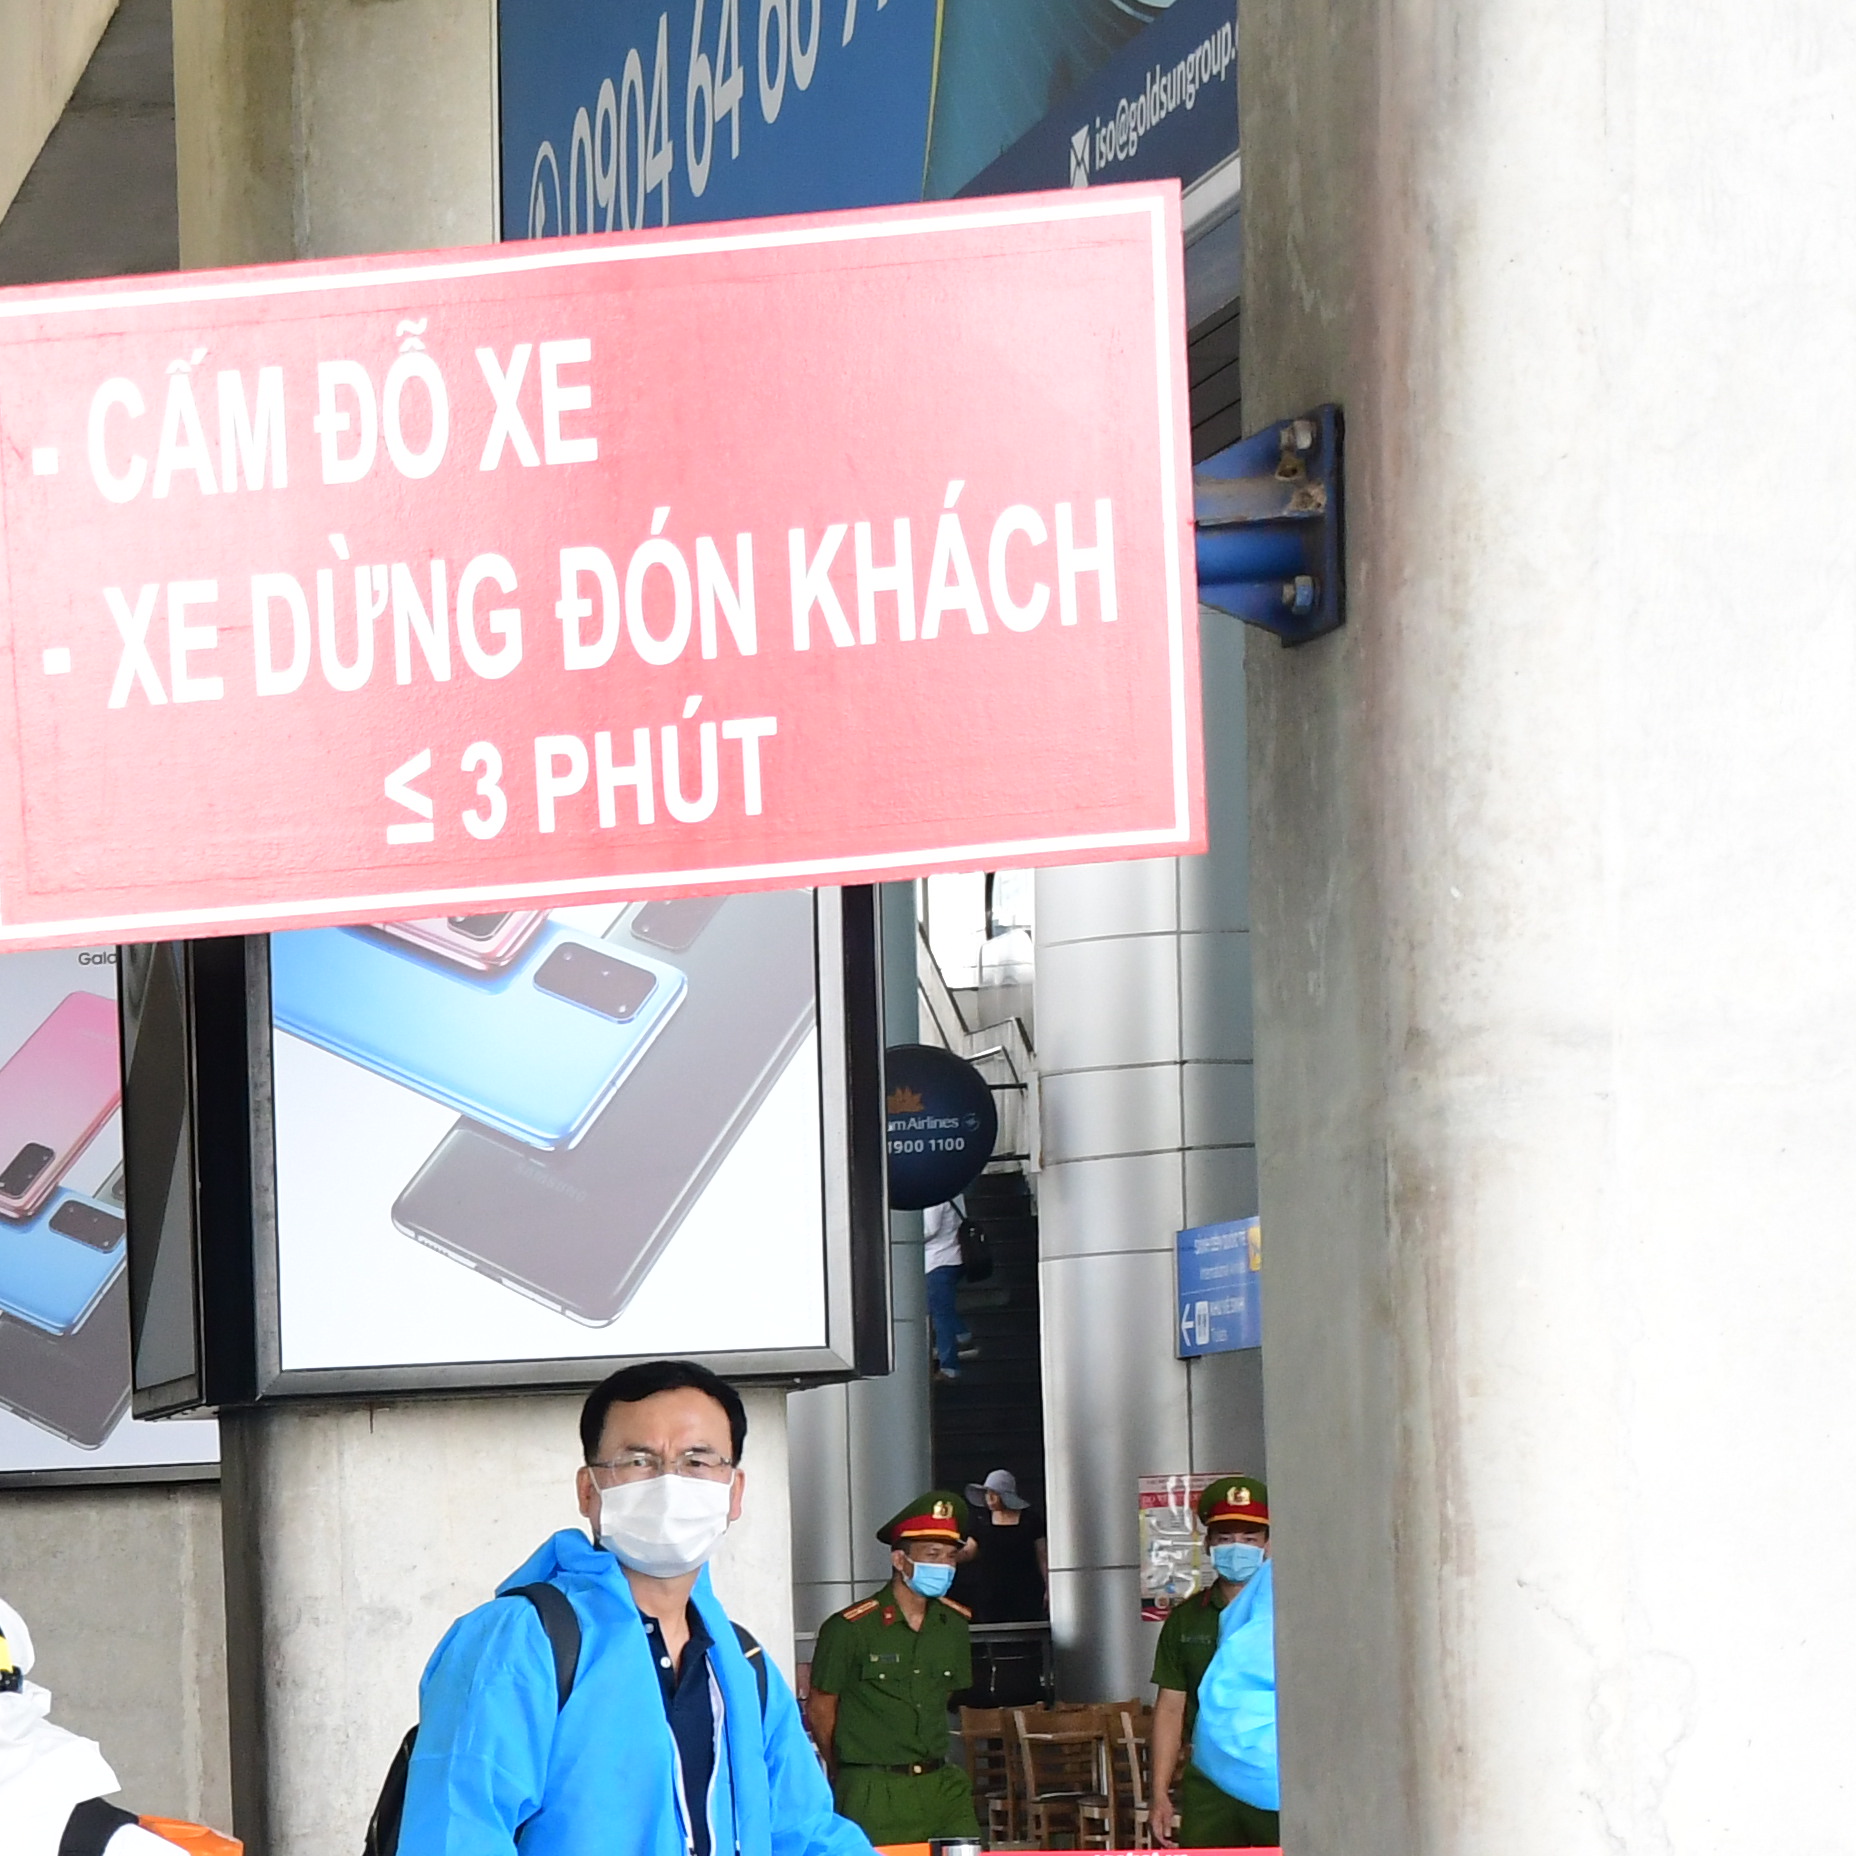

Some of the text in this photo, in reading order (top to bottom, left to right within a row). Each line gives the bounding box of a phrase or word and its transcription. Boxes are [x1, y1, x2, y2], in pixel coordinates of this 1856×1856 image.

[569, 11, 673, 236] 0904
[686, 0, 745, 198] 64
[1095, 21, 1238, 171] iso@goldsungroup.
[88, 317, 600, 504] CẤM ĐỖ XE
[103, 481, 1119, 710] XE DỪNG ĐÓN KHÁCH
[460, 736, 508, 840] 3
[535, 694, 778, 834] PHÚT
[888, 1137, 965, 1154] 1900 1100
[907, 1116, 960, 1130] Airlines
